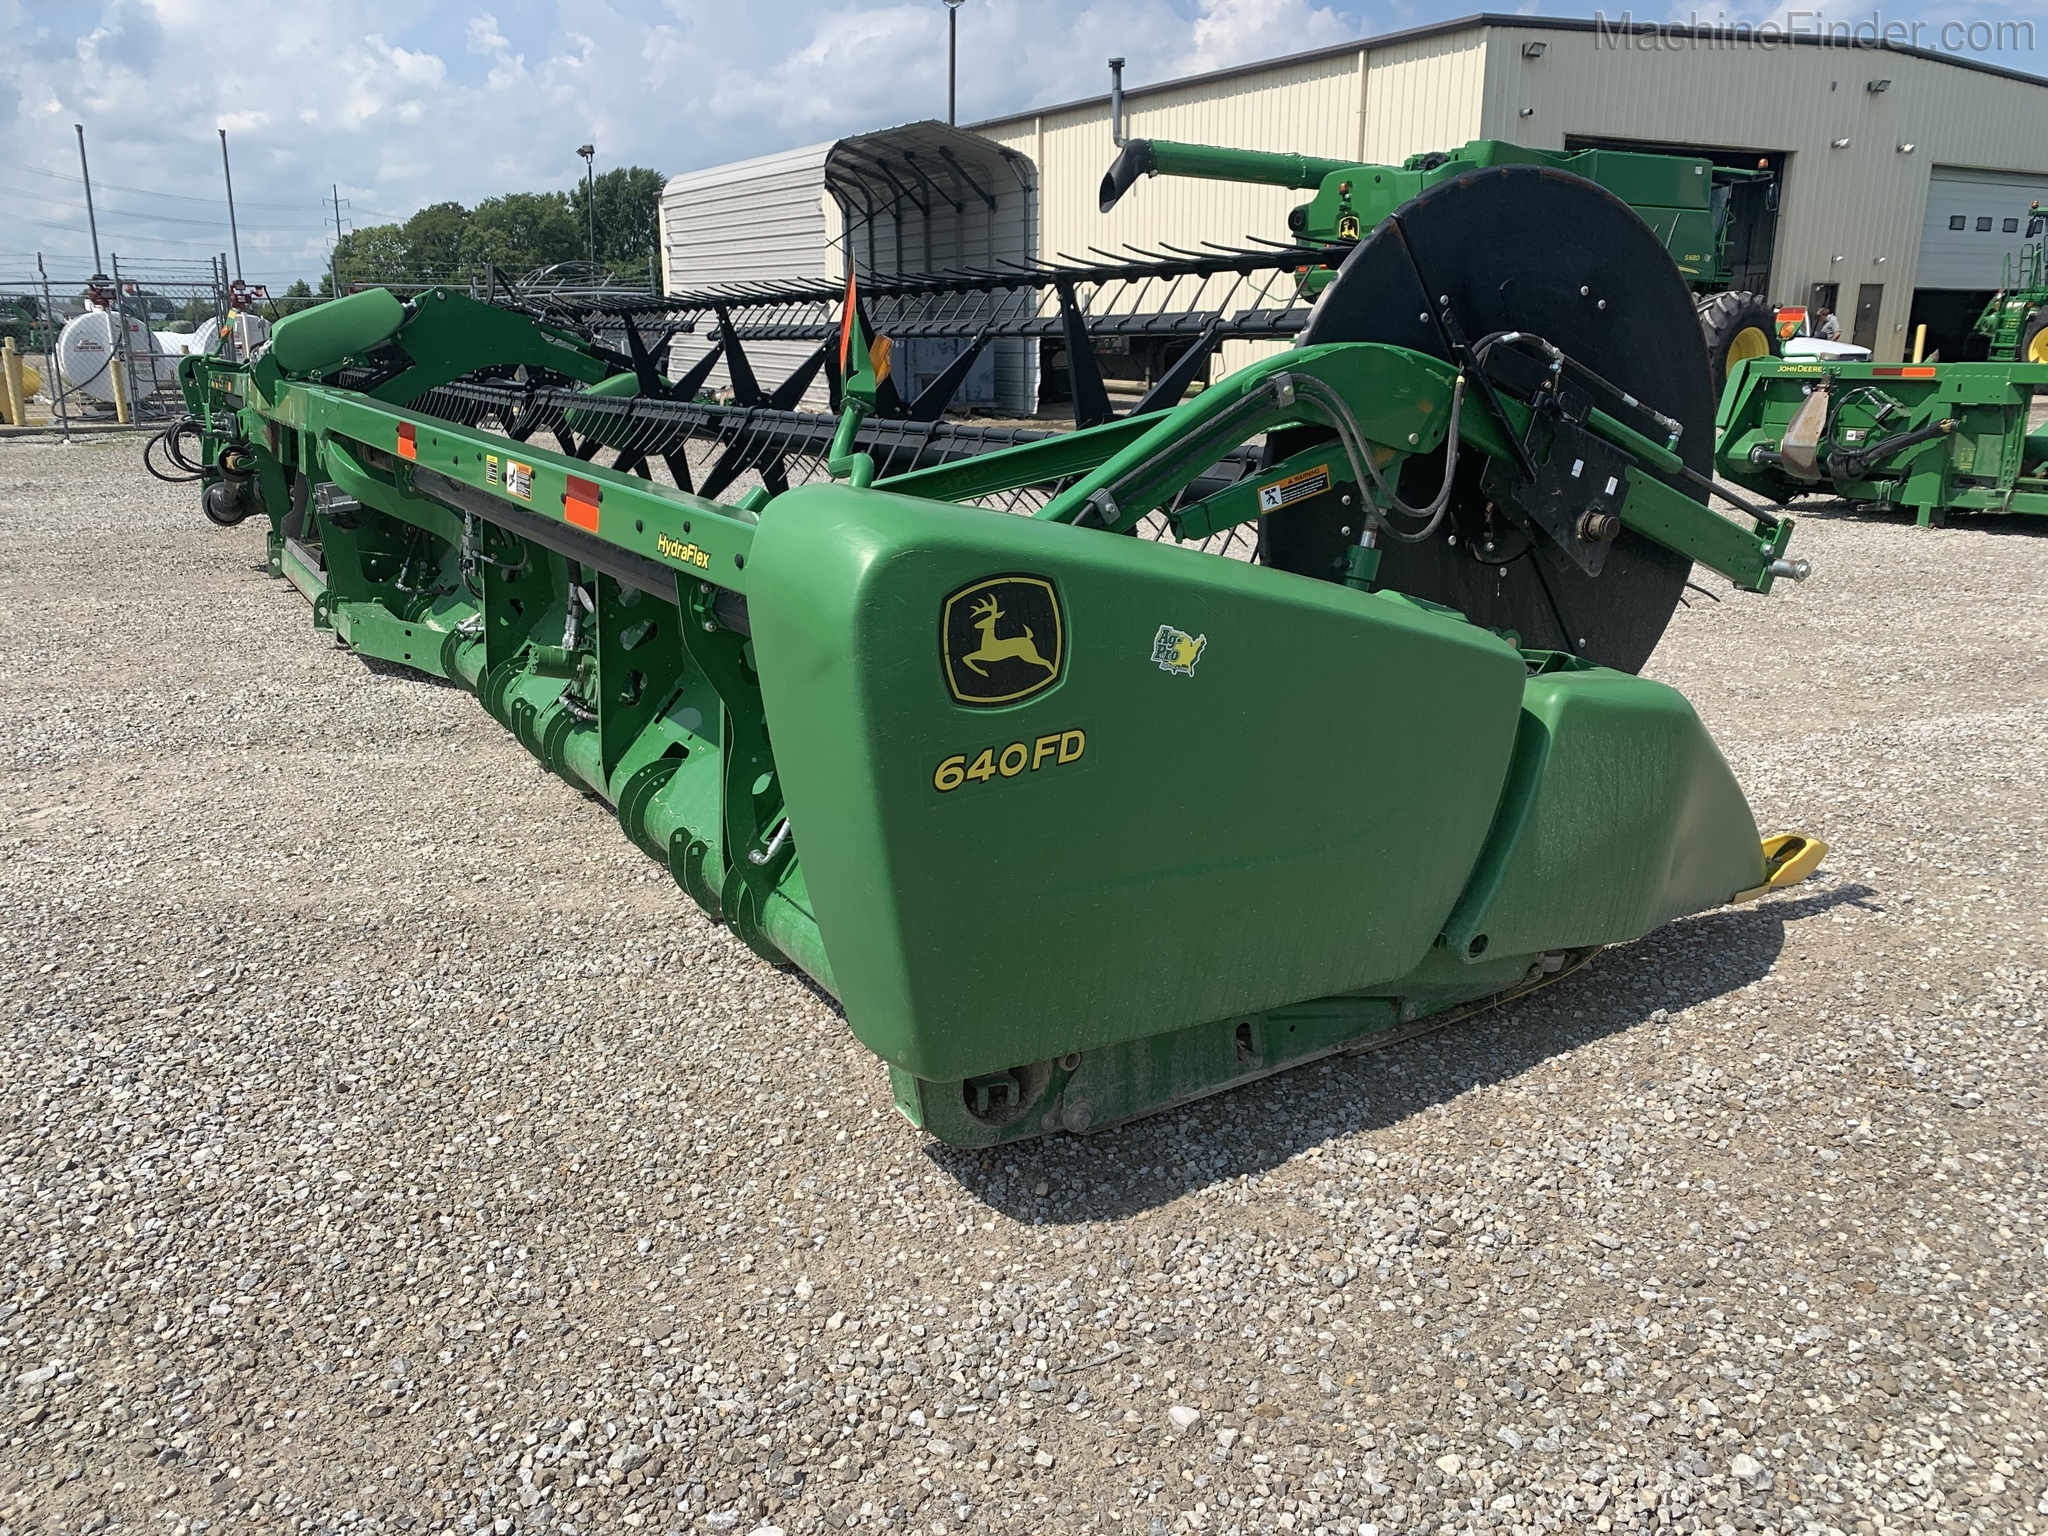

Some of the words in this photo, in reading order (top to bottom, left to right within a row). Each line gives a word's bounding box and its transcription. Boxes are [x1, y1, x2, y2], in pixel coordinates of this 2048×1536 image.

[1797, 365, 1823, 373] DEERE
[1294, 468, 1320, 482] WARNING
[657, 531, 712, 570] HydraFlex
[1158, 629, 1182, 648] Ag-
[1155, 644, 1179, 661] Pro
[933, 728, 1086, 793] 640FD
